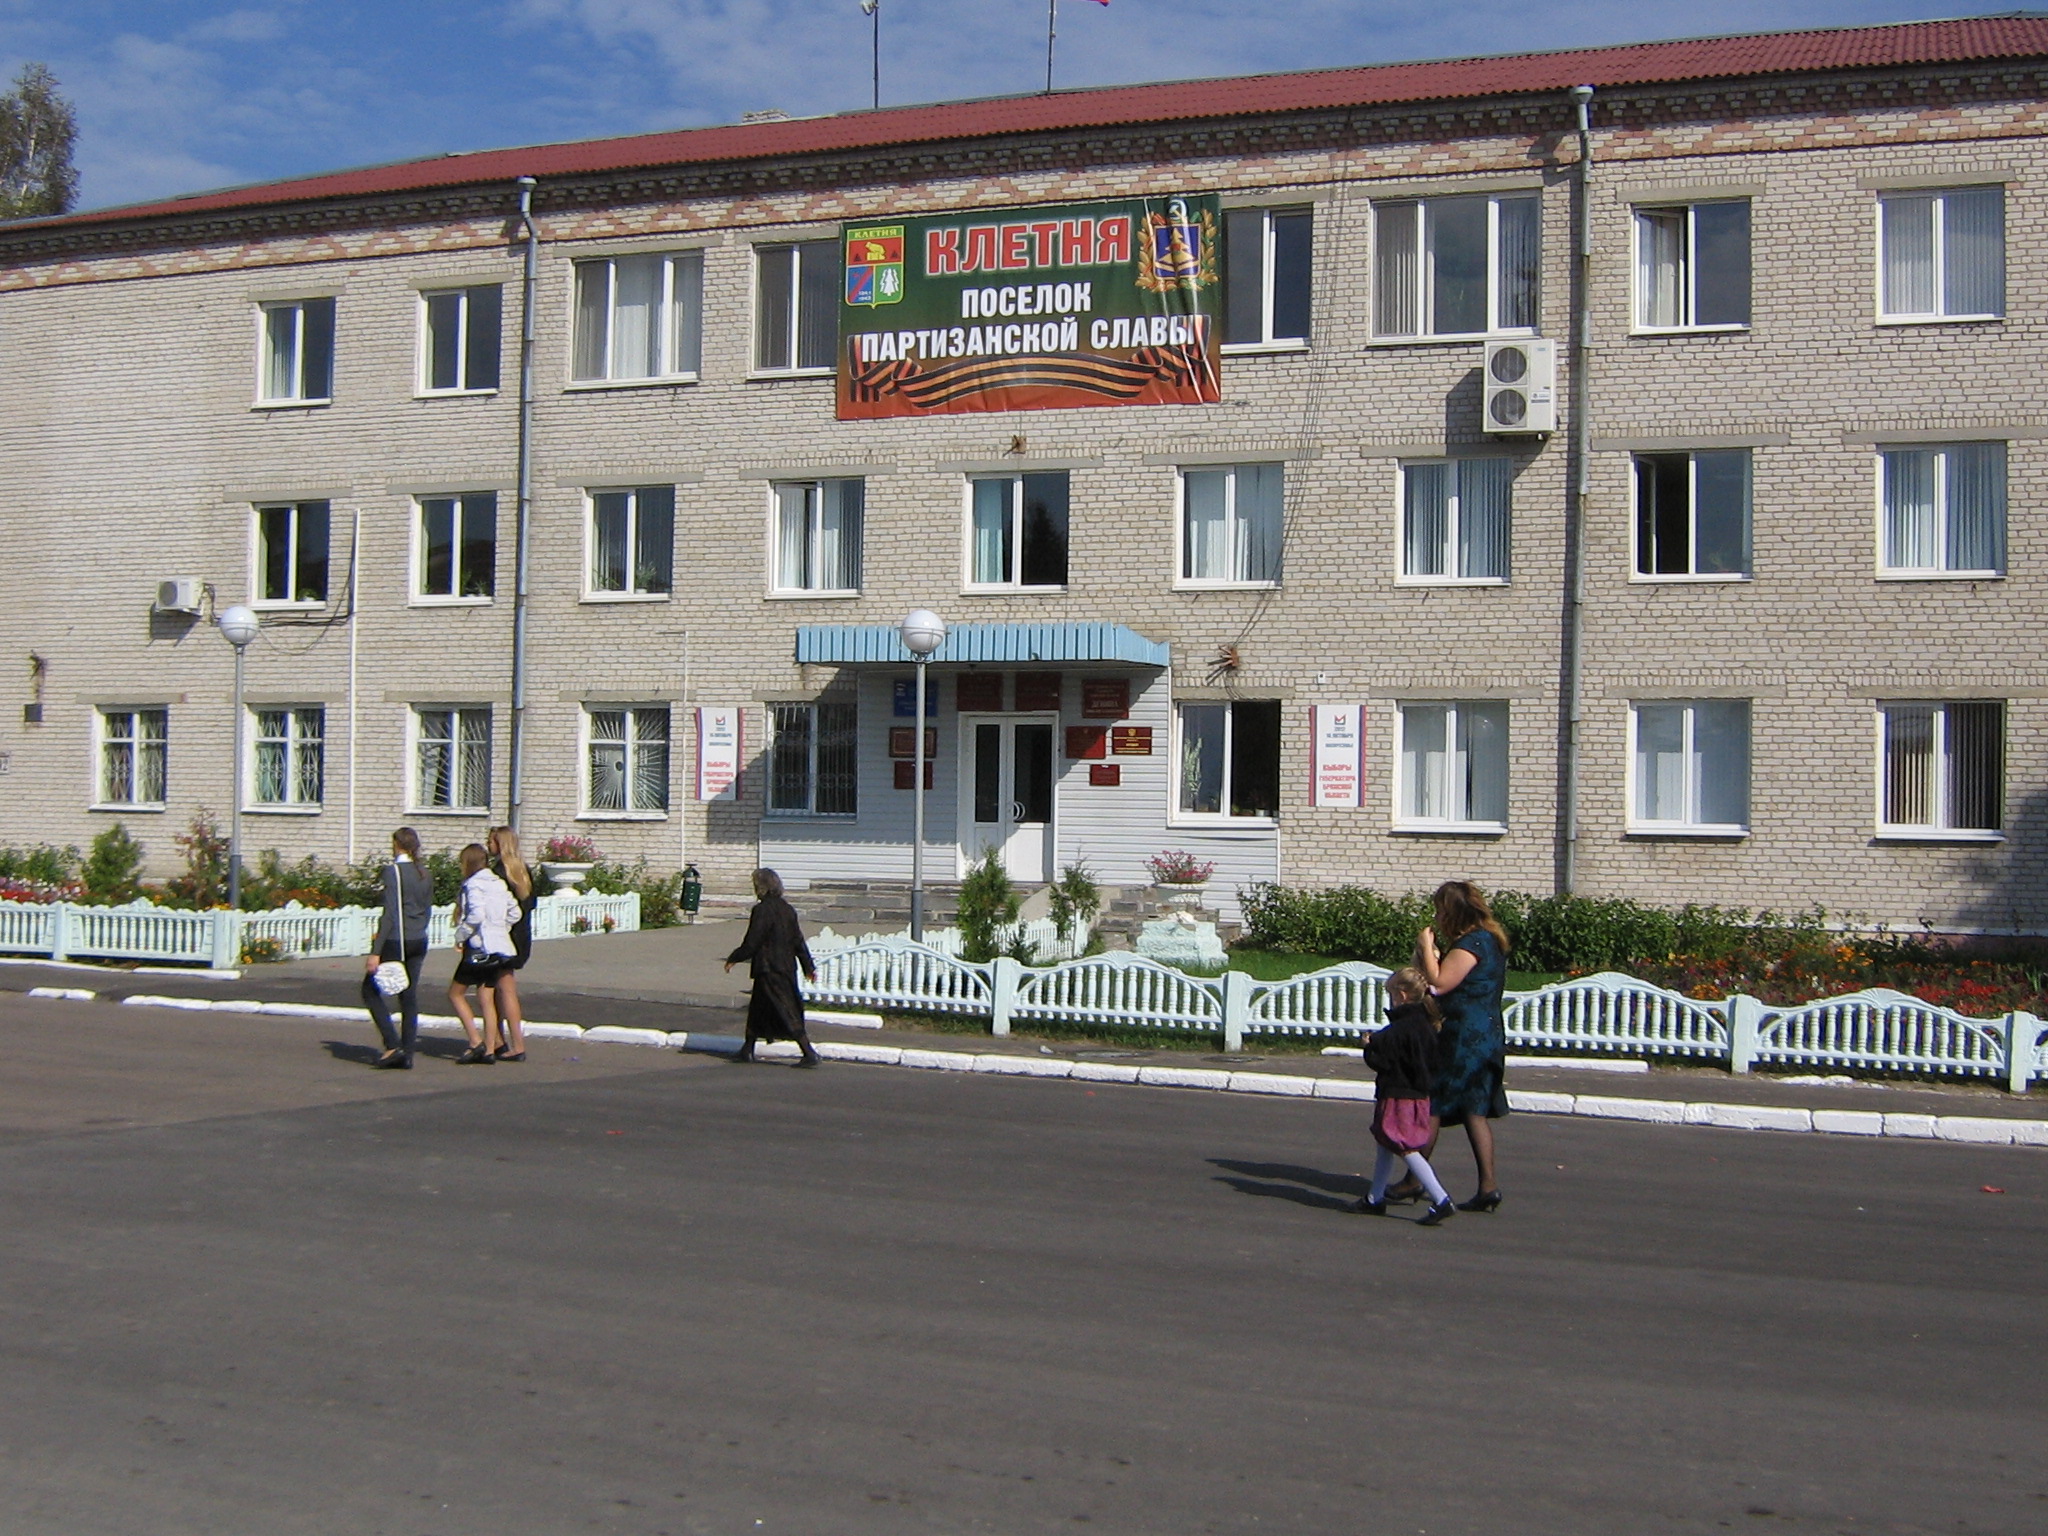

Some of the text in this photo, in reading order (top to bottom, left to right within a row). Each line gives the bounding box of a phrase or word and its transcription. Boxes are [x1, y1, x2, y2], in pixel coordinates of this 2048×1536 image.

[854, 228, 898, 238] КЛЕТНЯ
[926, 215, 1131, 275] КЛЕТНЯ
[962, 282, 1091, 318] ПОСЕЛОК
[862, 317, 1078, 362] ПАРТИЗАНСКОЙ
[1091, 315, 1195, 350] СЛАВЫ
